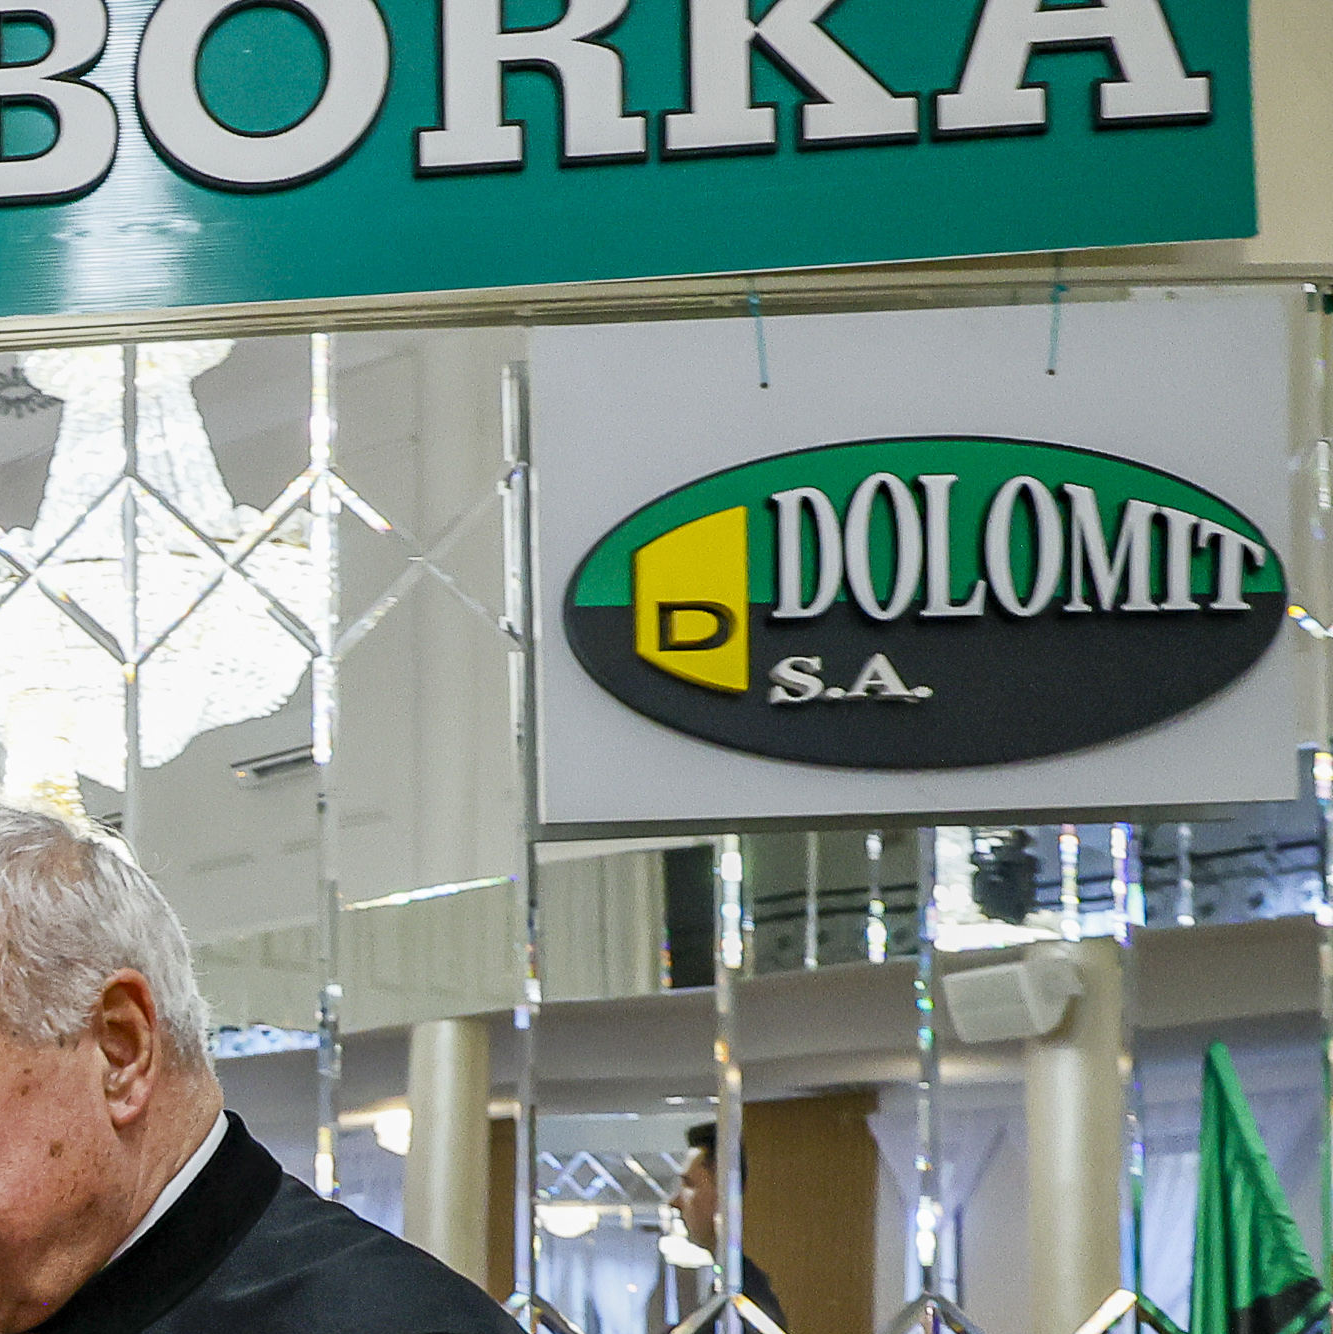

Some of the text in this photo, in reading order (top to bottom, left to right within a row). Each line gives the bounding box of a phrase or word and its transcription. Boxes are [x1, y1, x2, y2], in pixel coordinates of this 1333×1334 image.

[770, 471, 1266, 621] DOLOMIT
[656, 600, 736, 652] D
[768, 653, 935, 704] S.A.
